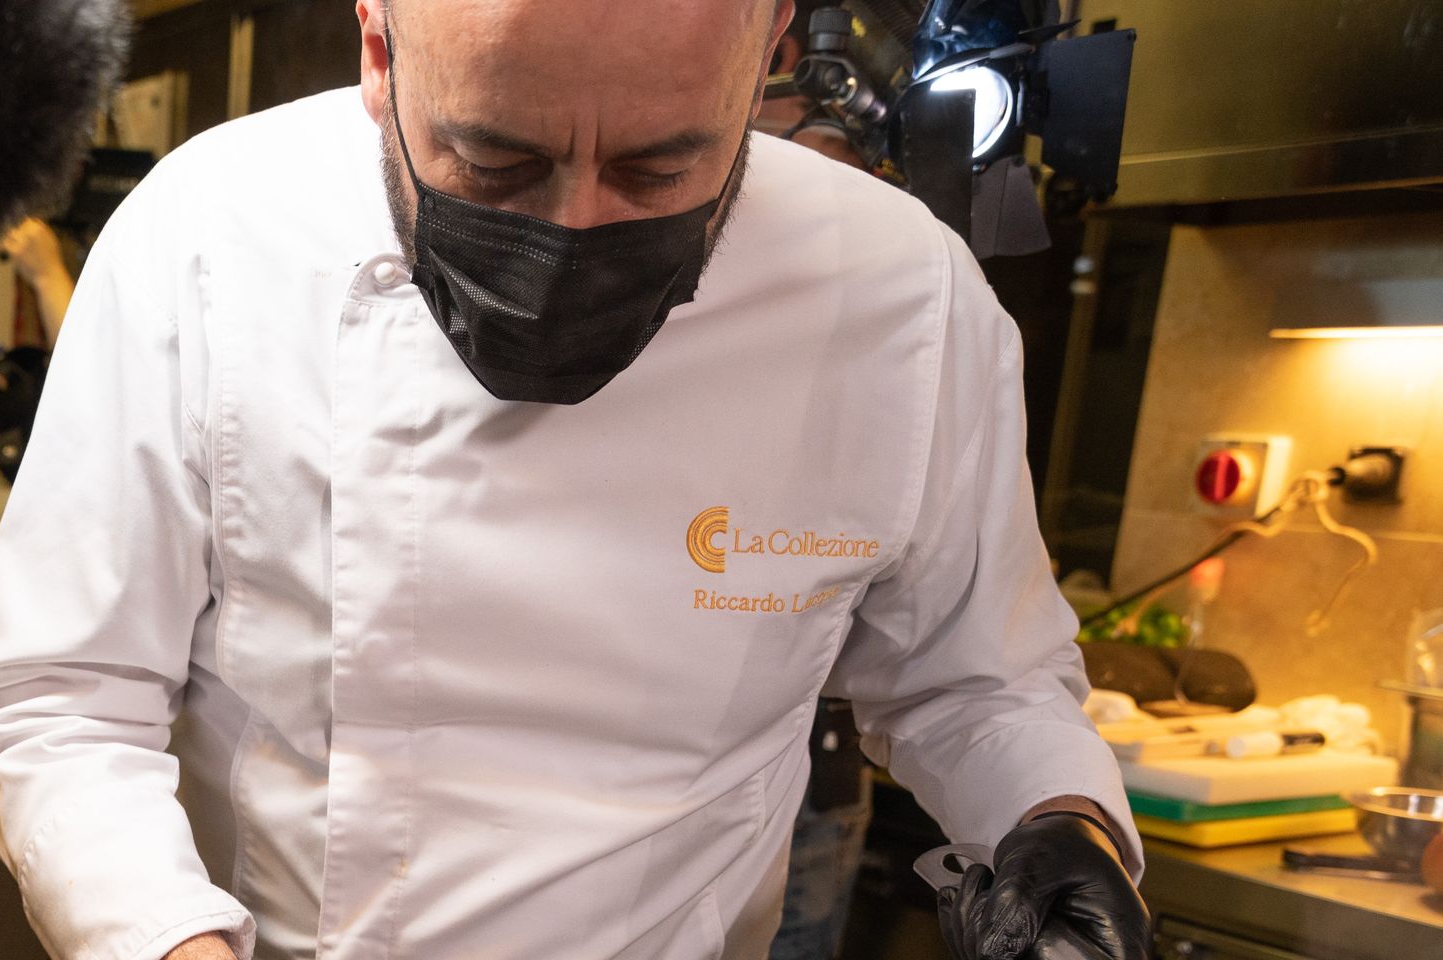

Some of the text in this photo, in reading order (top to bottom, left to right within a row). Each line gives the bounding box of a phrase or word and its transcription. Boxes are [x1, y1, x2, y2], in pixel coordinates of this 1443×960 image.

[732, 527, 881, 559] La Collezione
[693, 589, 786, 613] Riccardo
